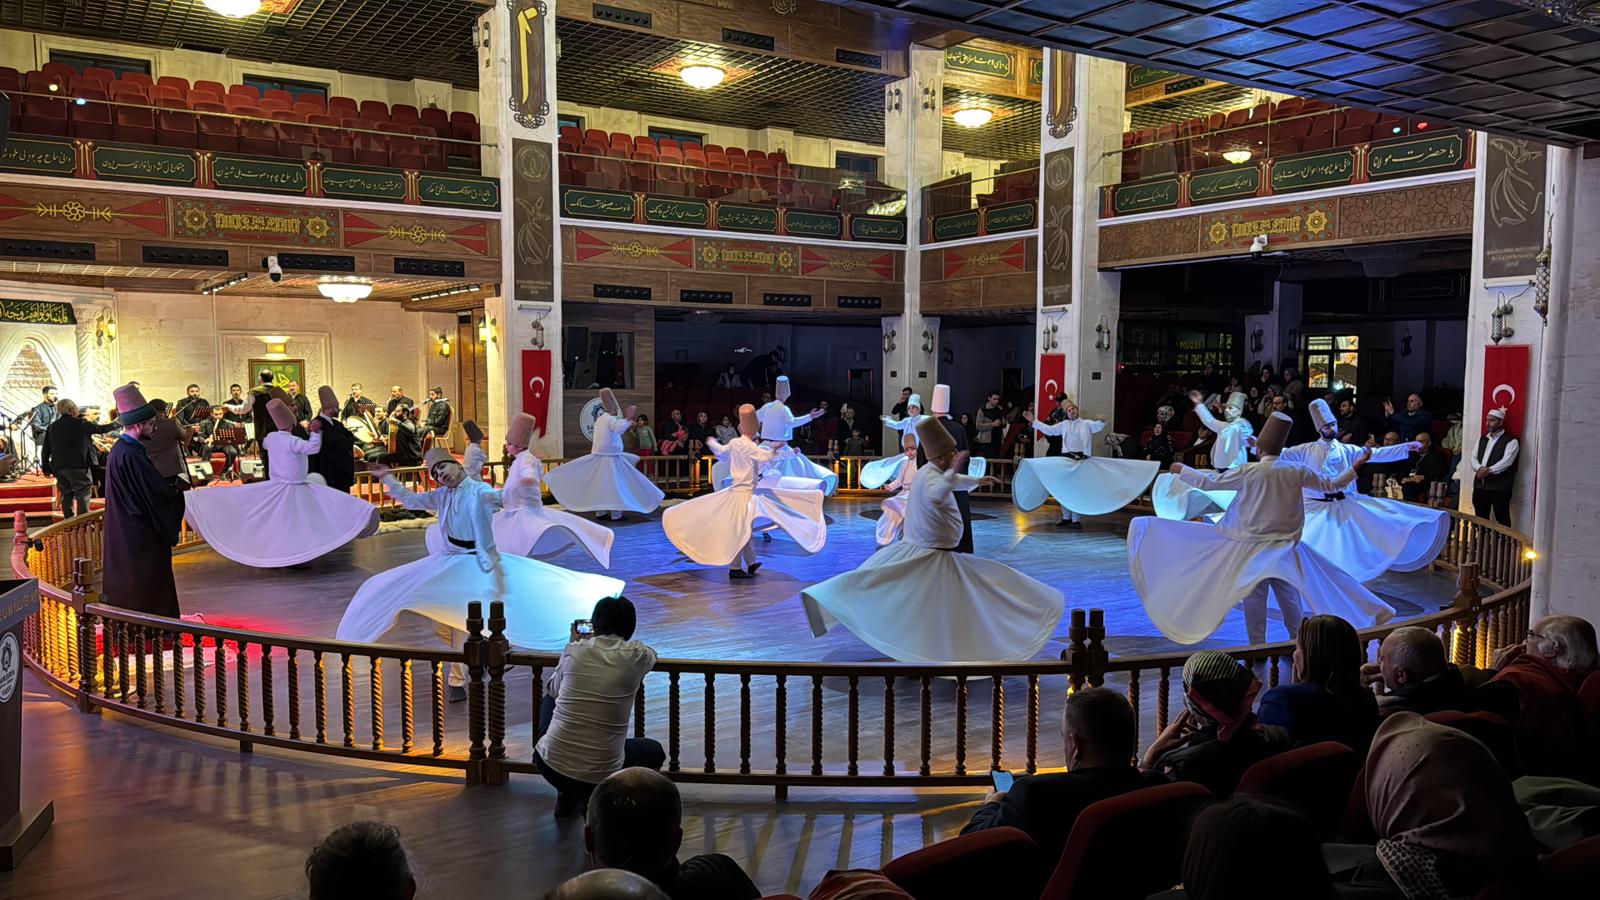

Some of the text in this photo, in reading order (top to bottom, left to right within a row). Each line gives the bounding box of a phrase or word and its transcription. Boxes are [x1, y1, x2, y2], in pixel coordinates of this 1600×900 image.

[1373, 142, 1455, 168] یا حضرت مولانا
